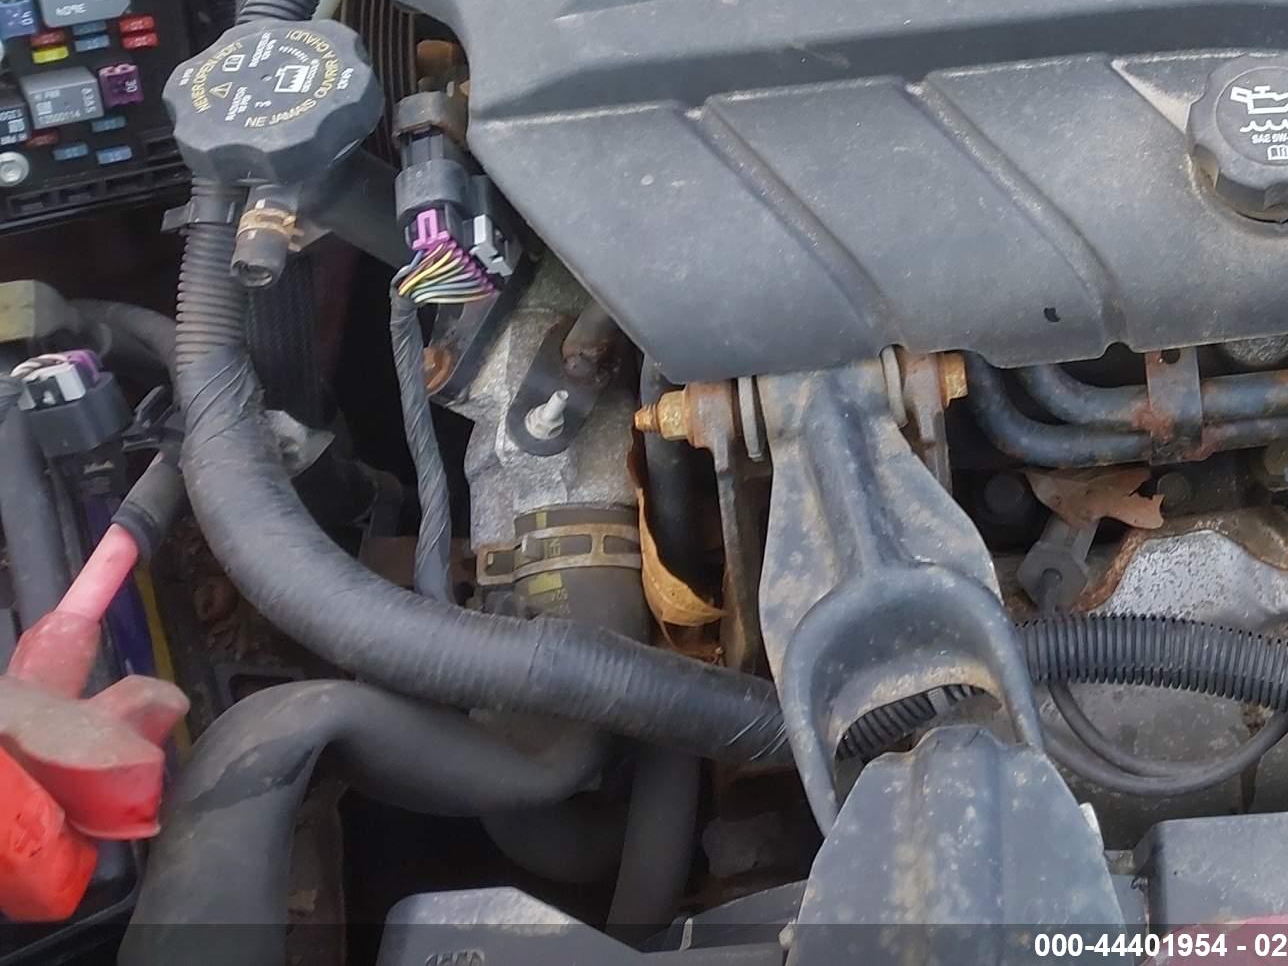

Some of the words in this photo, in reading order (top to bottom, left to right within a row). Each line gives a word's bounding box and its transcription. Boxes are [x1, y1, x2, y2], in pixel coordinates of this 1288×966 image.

[244, 116, 266, 128] NE
[268, 97, 318, 125] JAMAIS
[1251, 133, 1271, 144] SAE
